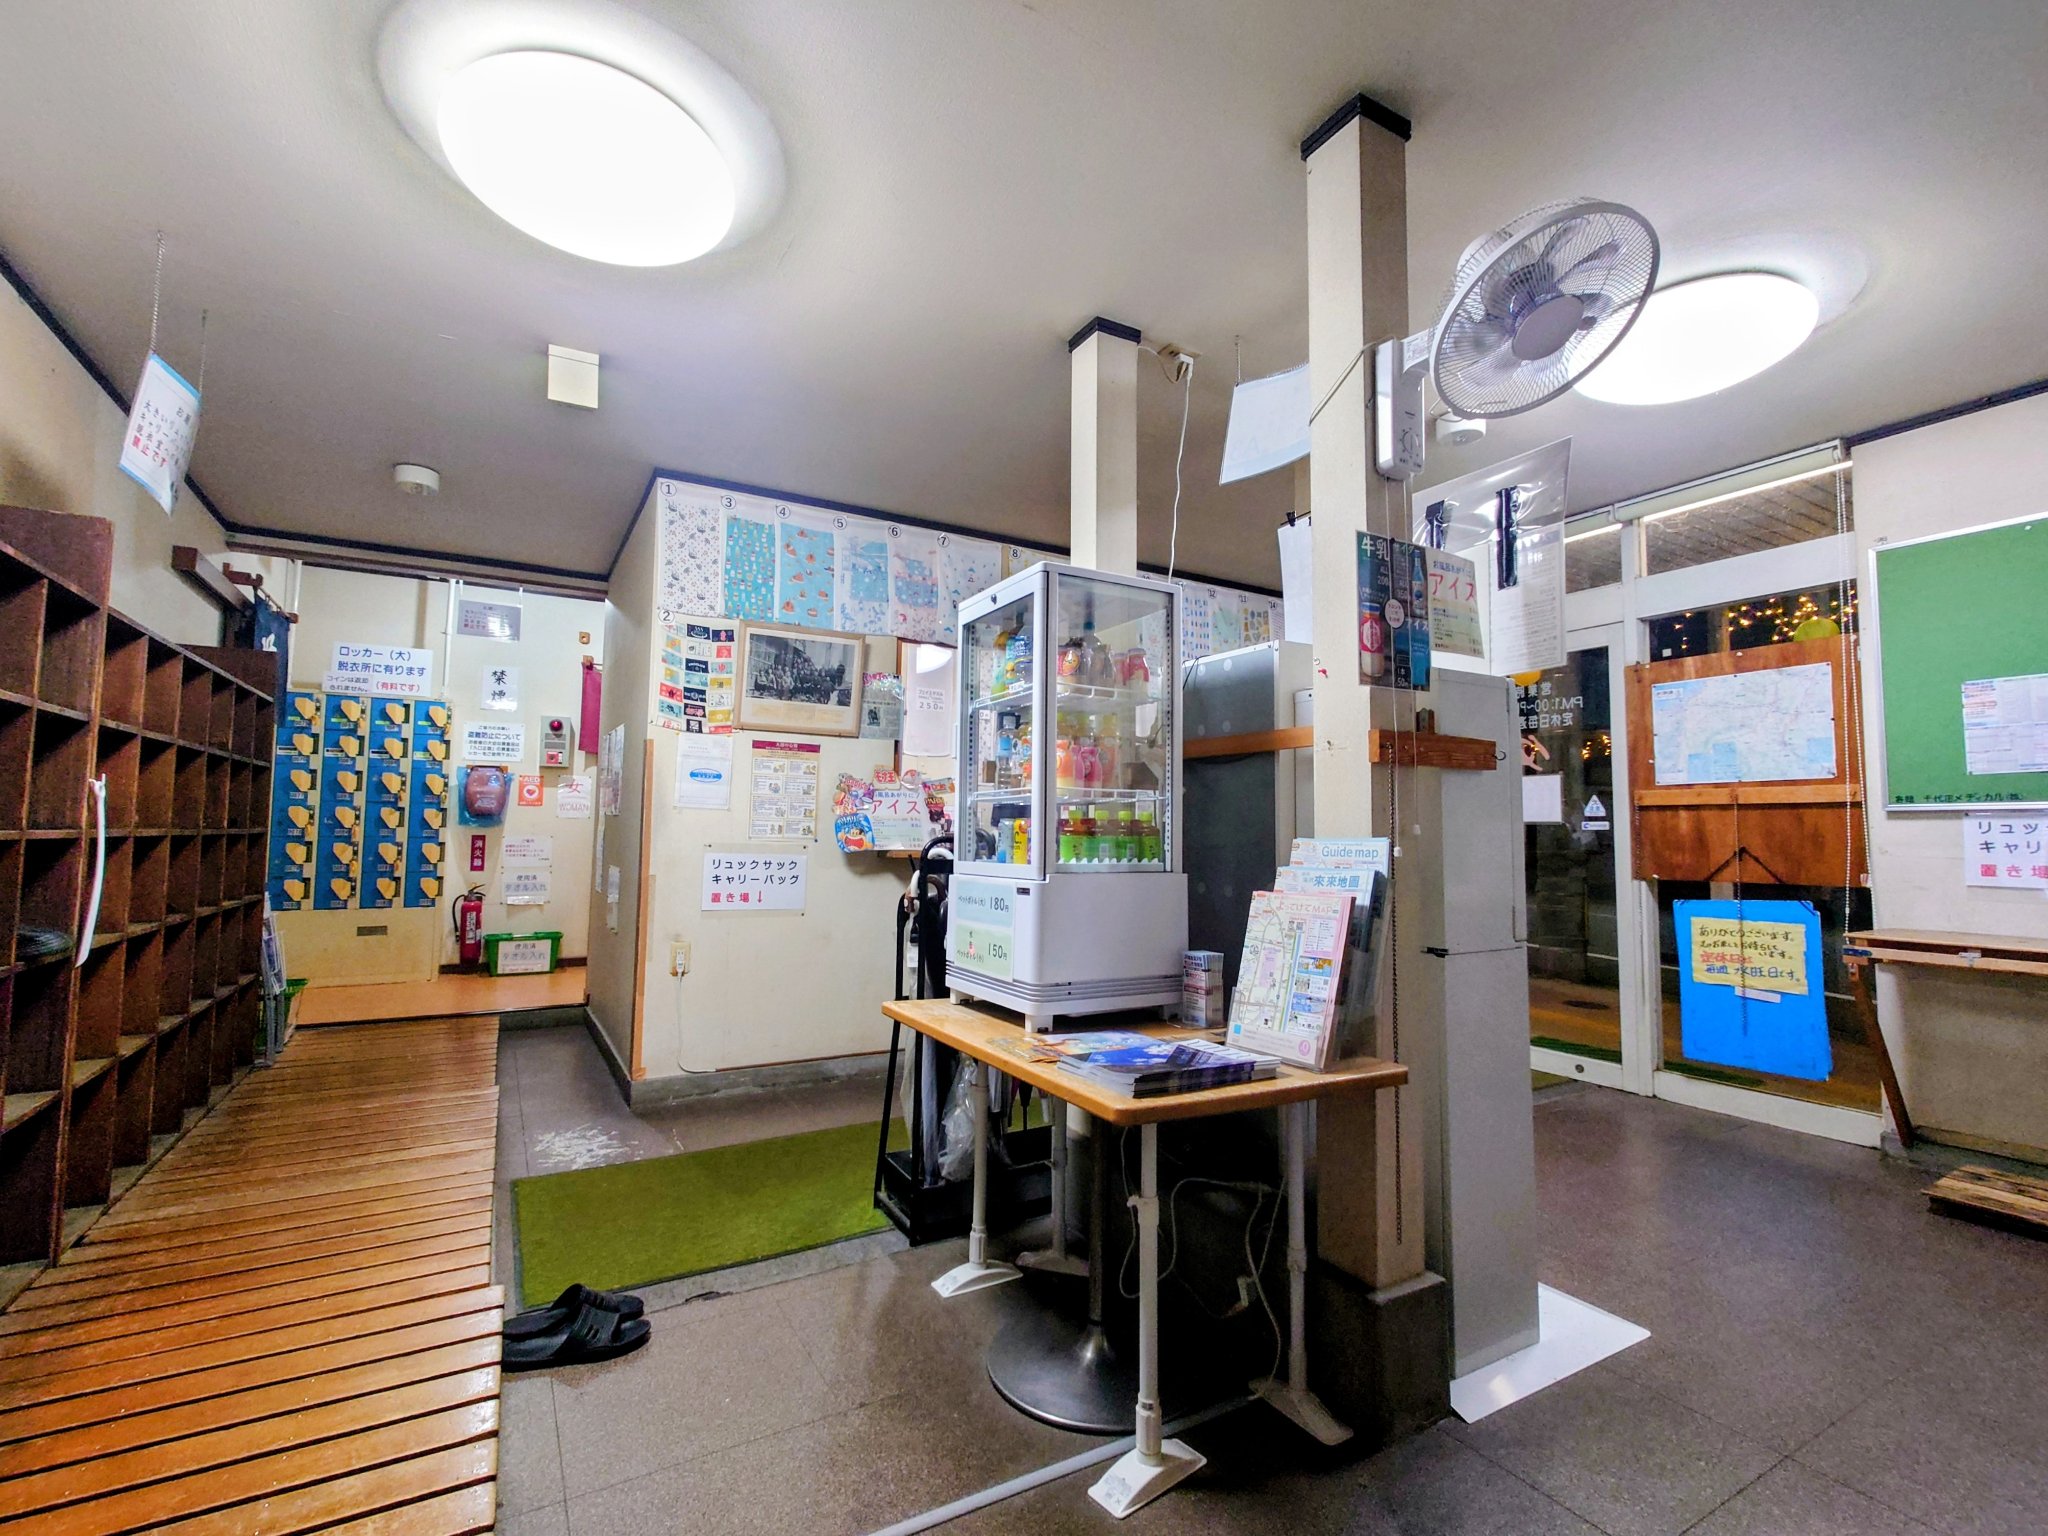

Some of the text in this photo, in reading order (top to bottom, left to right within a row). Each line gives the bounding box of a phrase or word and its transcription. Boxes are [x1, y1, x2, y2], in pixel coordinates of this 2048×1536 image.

[1428, 573, 1475, 601] アイス
[337, 661, 426, 677] 脱衣所に有ります
[1978, 822, 2048, 834] リュッ
[1321, 846, 1379, 859] Guide map
[712, 859, 798, 871] リュックサック
[712, 874, 800, 885] キャリーバッグ
[710, 893, 750, 904] 置き場
